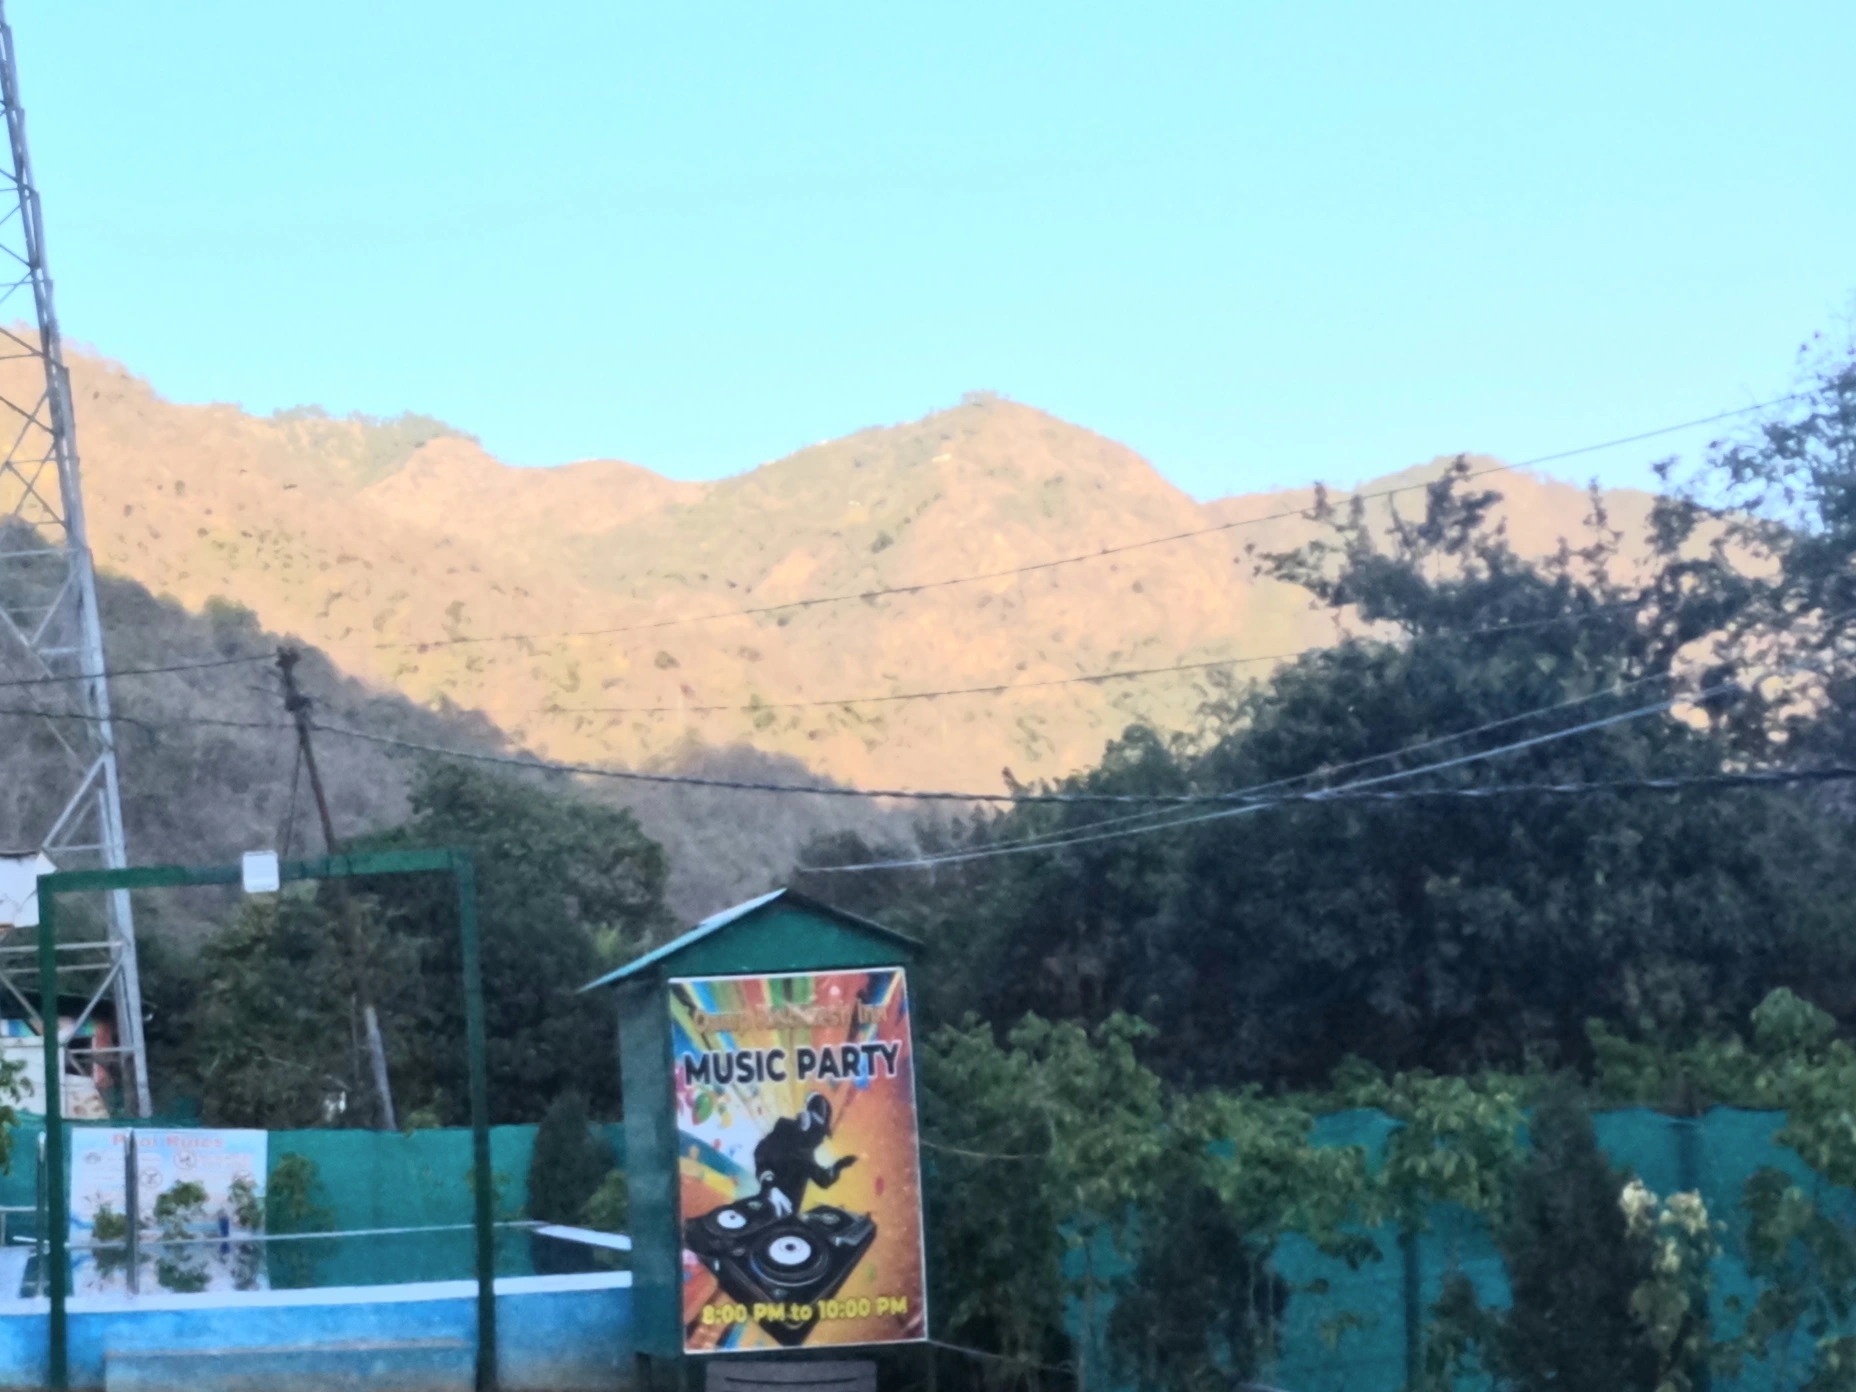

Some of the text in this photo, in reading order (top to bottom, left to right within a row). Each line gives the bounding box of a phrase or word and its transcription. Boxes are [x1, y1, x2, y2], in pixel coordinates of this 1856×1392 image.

[684, 1042, 901, 1086] MUSIC PARTY
[112, 1133, 156, 1148] Pol
[702, 1296, 908, 1325] 8:00 PM to 10:00 PM
